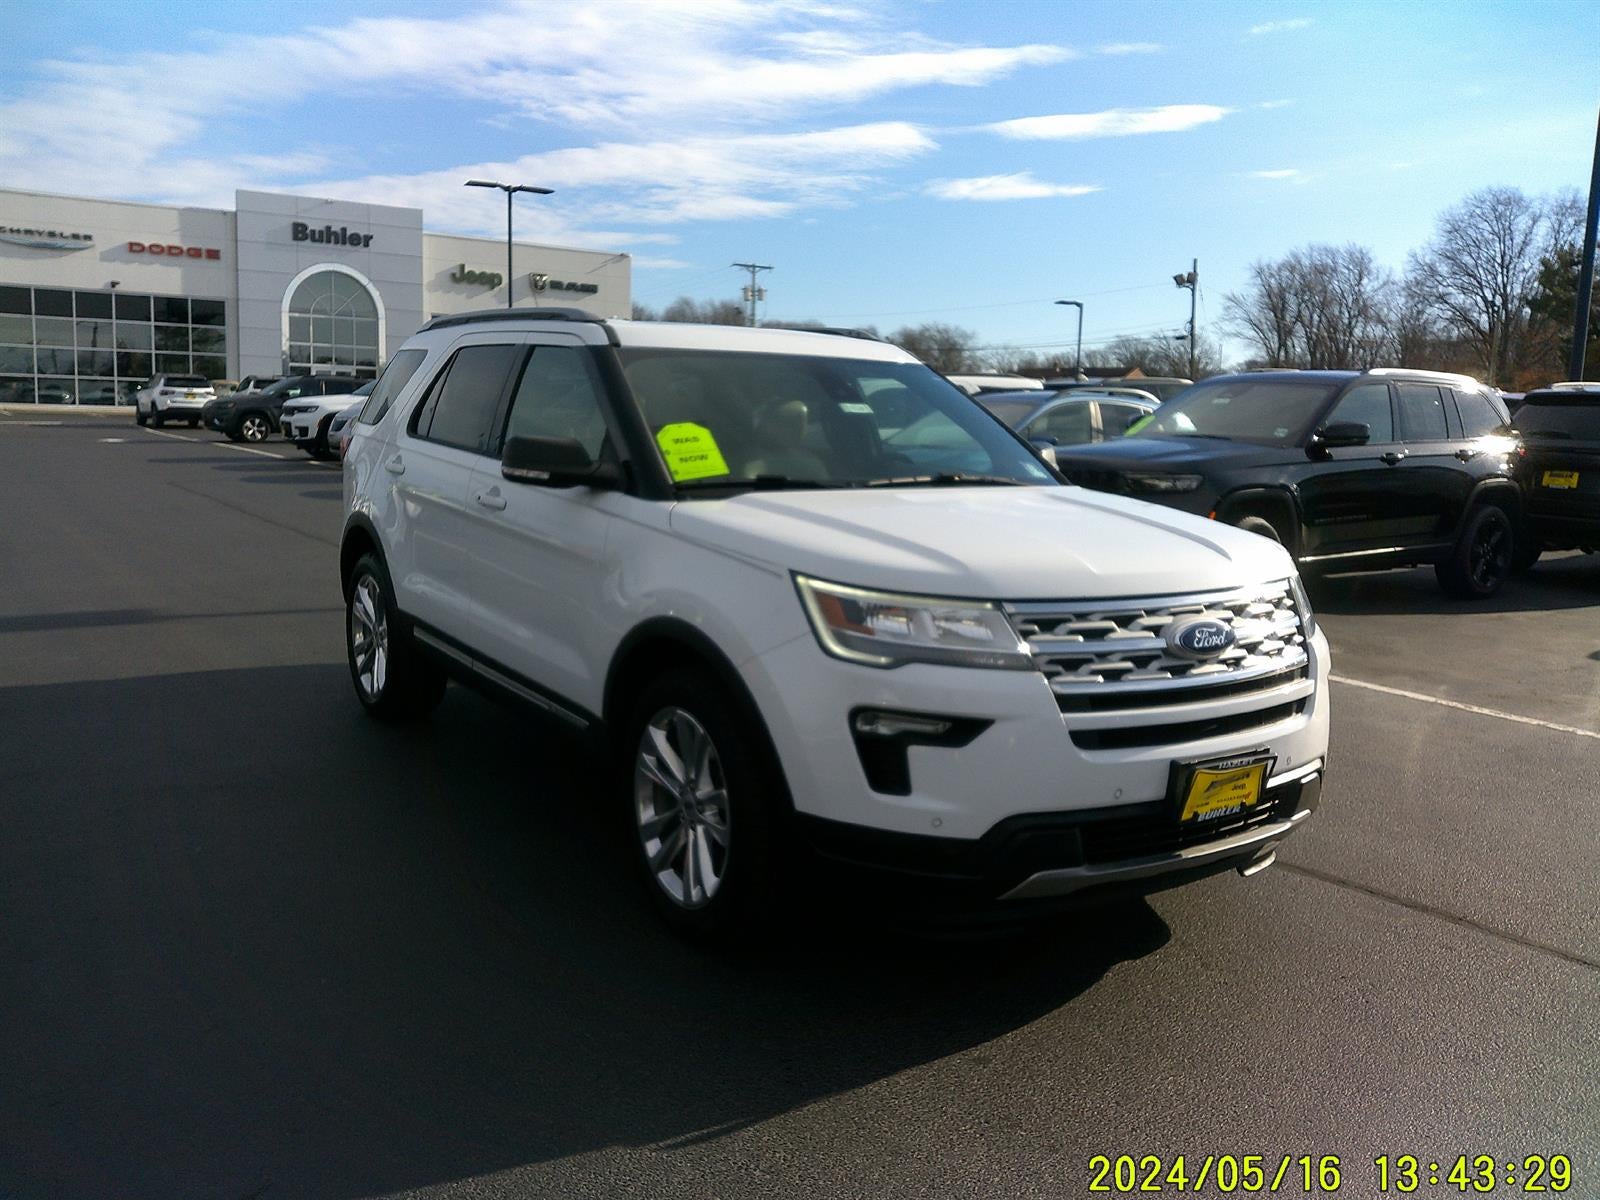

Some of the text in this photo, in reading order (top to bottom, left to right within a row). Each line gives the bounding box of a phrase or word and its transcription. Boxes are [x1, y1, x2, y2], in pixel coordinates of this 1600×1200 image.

[291, 221, 374, 248] Buhler
[128, 241, 221, 260] DODGE
[451, 263, 503, 290] Jeep
[1193, 627, 1226, 648] Ford
